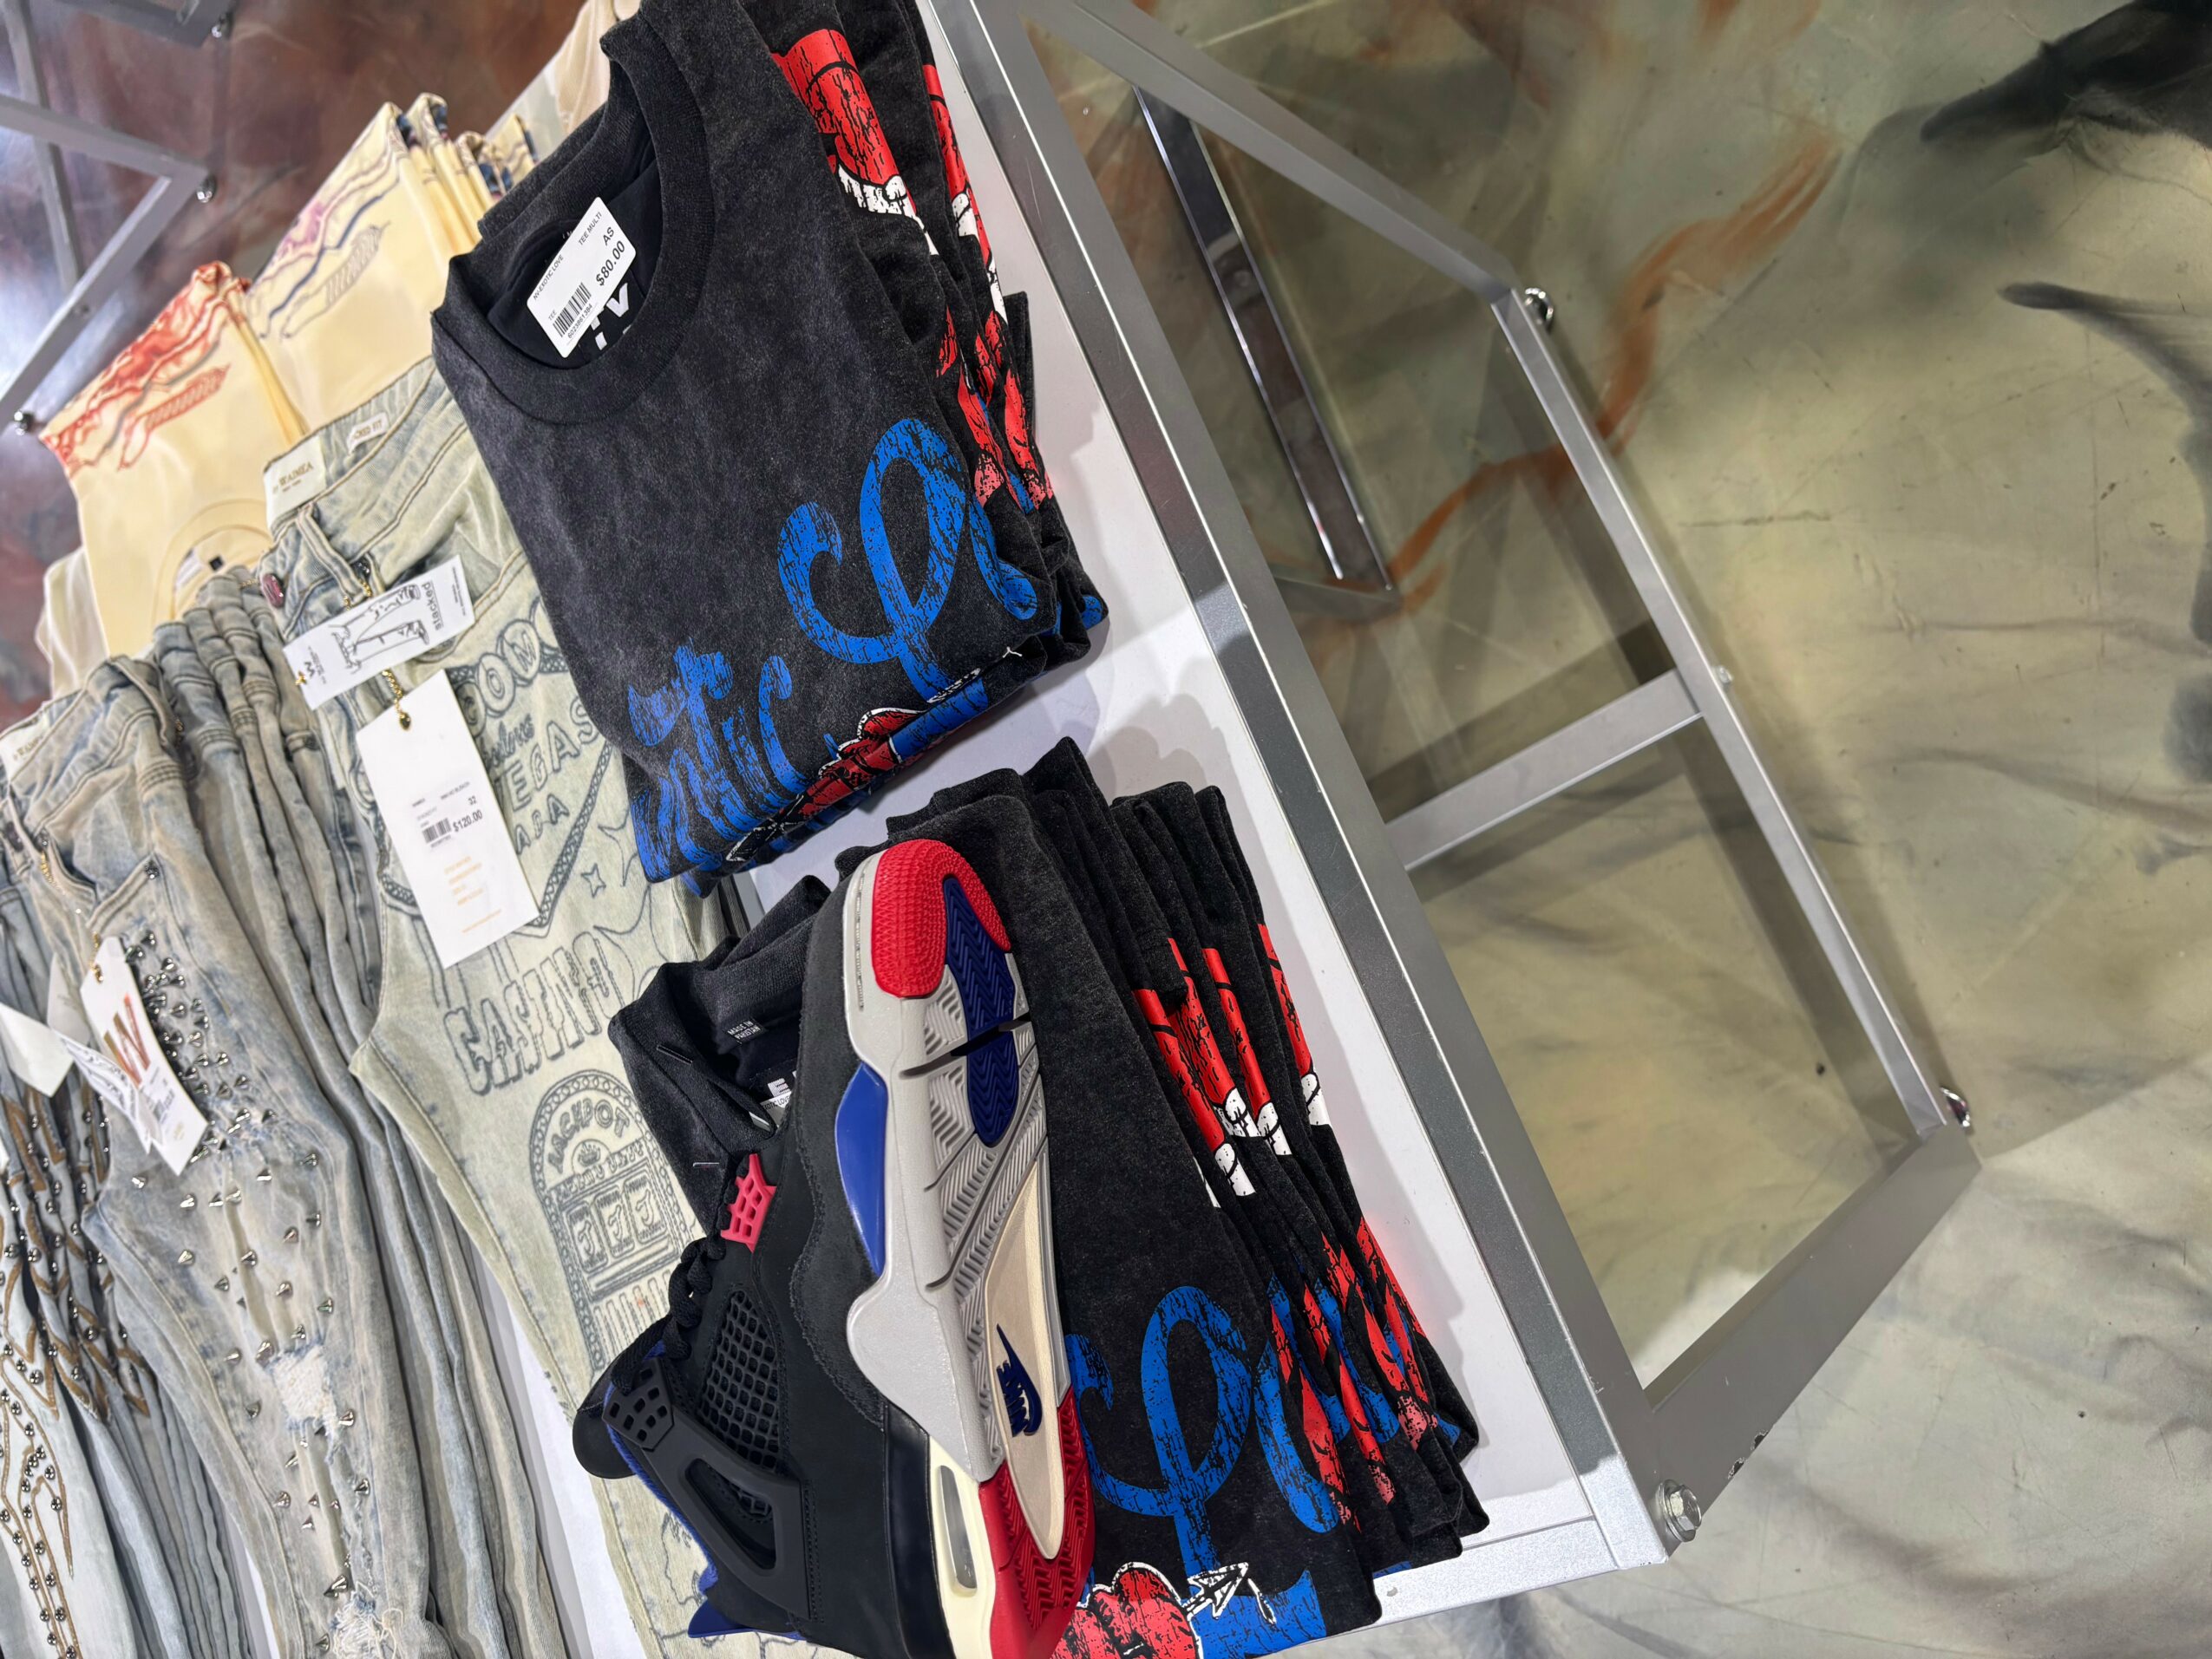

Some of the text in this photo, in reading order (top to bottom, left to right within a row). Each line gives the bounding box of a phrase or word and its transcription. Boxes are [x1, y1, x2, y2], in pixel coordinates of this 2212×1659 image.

[578, 211, 603, 246] TEE MULTI
[602, 226, 615, 246] AS
[533, 254, 565, 301] NV-EXOTIC LOVE
[595, 240, 625, 287] $80.00
[547, 309, 558, 322] TEE
[422, 581, 442, 631] stacked
[496, 696, 600, 813] EGAS
[452, 809, 483, 833] $120.00
[443, 931, 625, 1096] CASINO
[727, 1022, 747, 1035] MADE
[734, 1025, 762, 1040] PAKISTAN
[547, 1097, 631, 1174] JACKPOT
[996, 1359, 1030, 1438] NIKE
